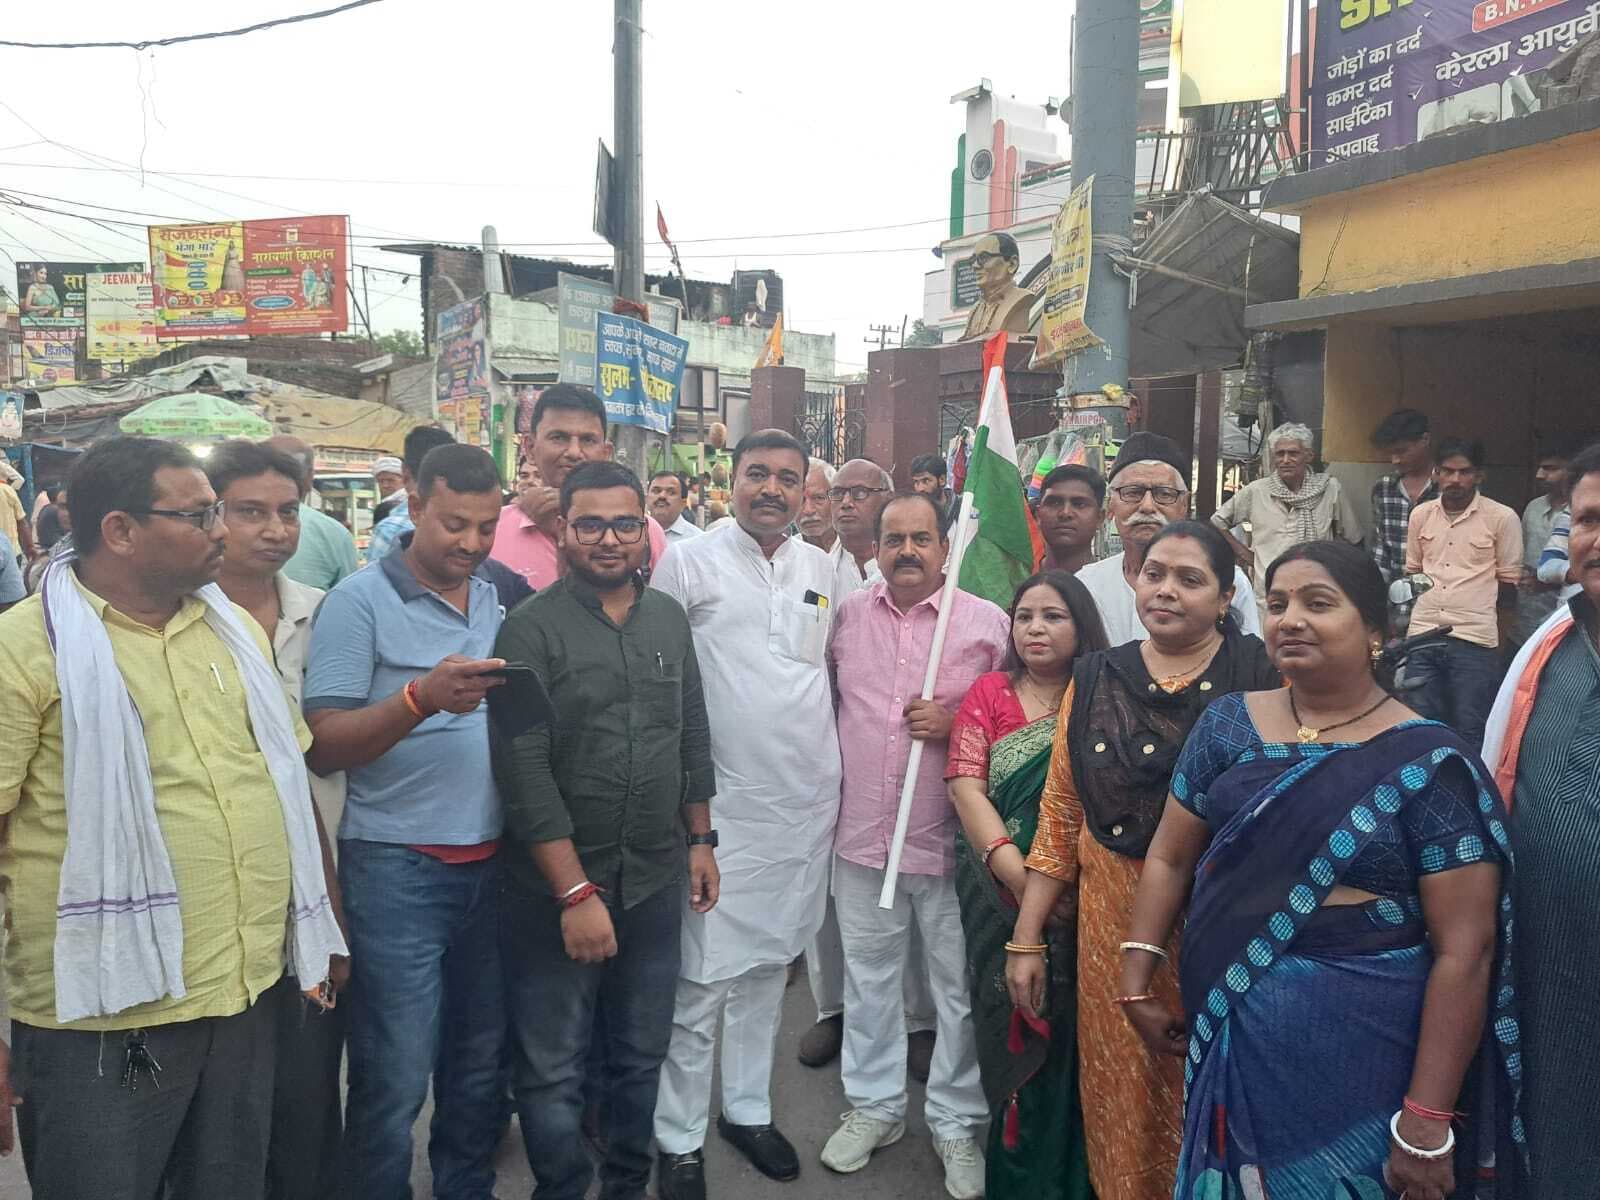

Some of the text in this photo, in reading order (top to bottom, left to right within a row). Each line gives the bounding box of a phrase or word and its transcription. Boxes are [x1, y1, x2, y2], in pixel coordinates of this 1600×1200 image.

[1328, 24, 1423, 80] जोड़ों का दर्द
[1435, 41, 1511, 81] केरला
[1327, 64, 1394, 107] कमर दर्द
[1326, 100, 1393, 136] साईटिका
[102, 273, 137, 286] JEEVAN
